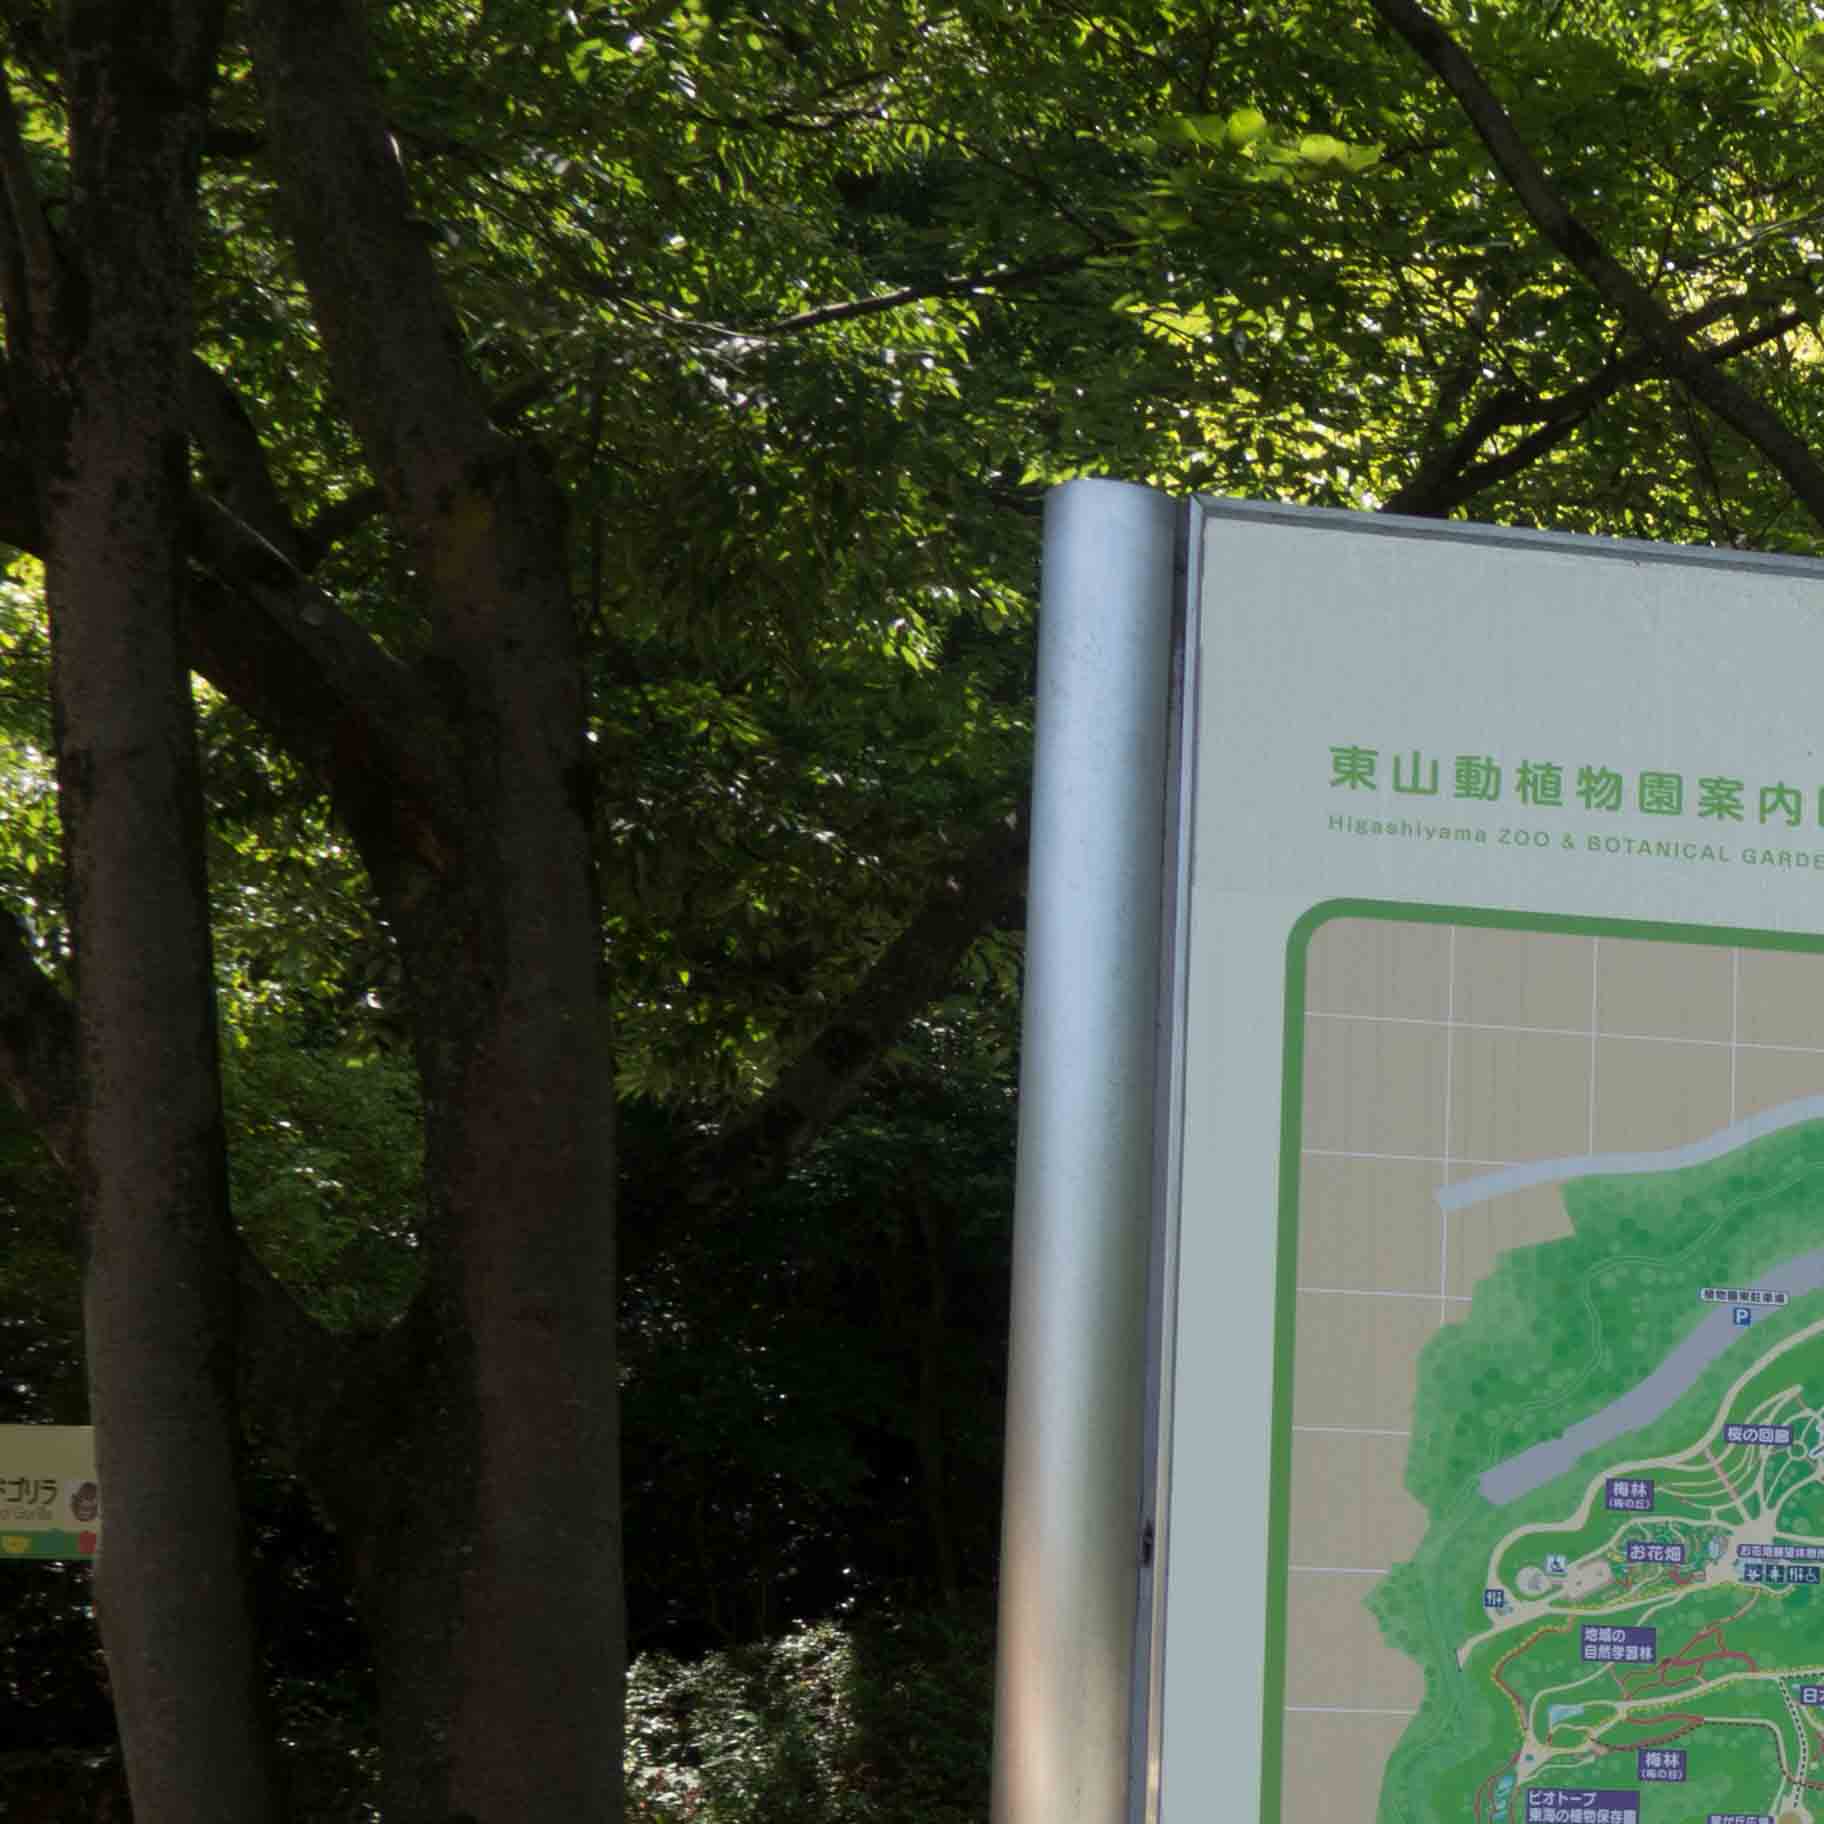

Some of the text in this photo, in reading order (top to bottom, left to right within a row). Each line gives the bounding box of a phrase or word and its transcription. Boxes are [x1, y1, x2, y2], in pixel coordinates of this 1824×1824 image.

[1328, 814, 1487, 845] Higashiyama
[1498, 830, 1551, 848] ZOO
[1562, 834, 1575, 851] &
[1588, 836, 1729, 864] BOTANICAL
